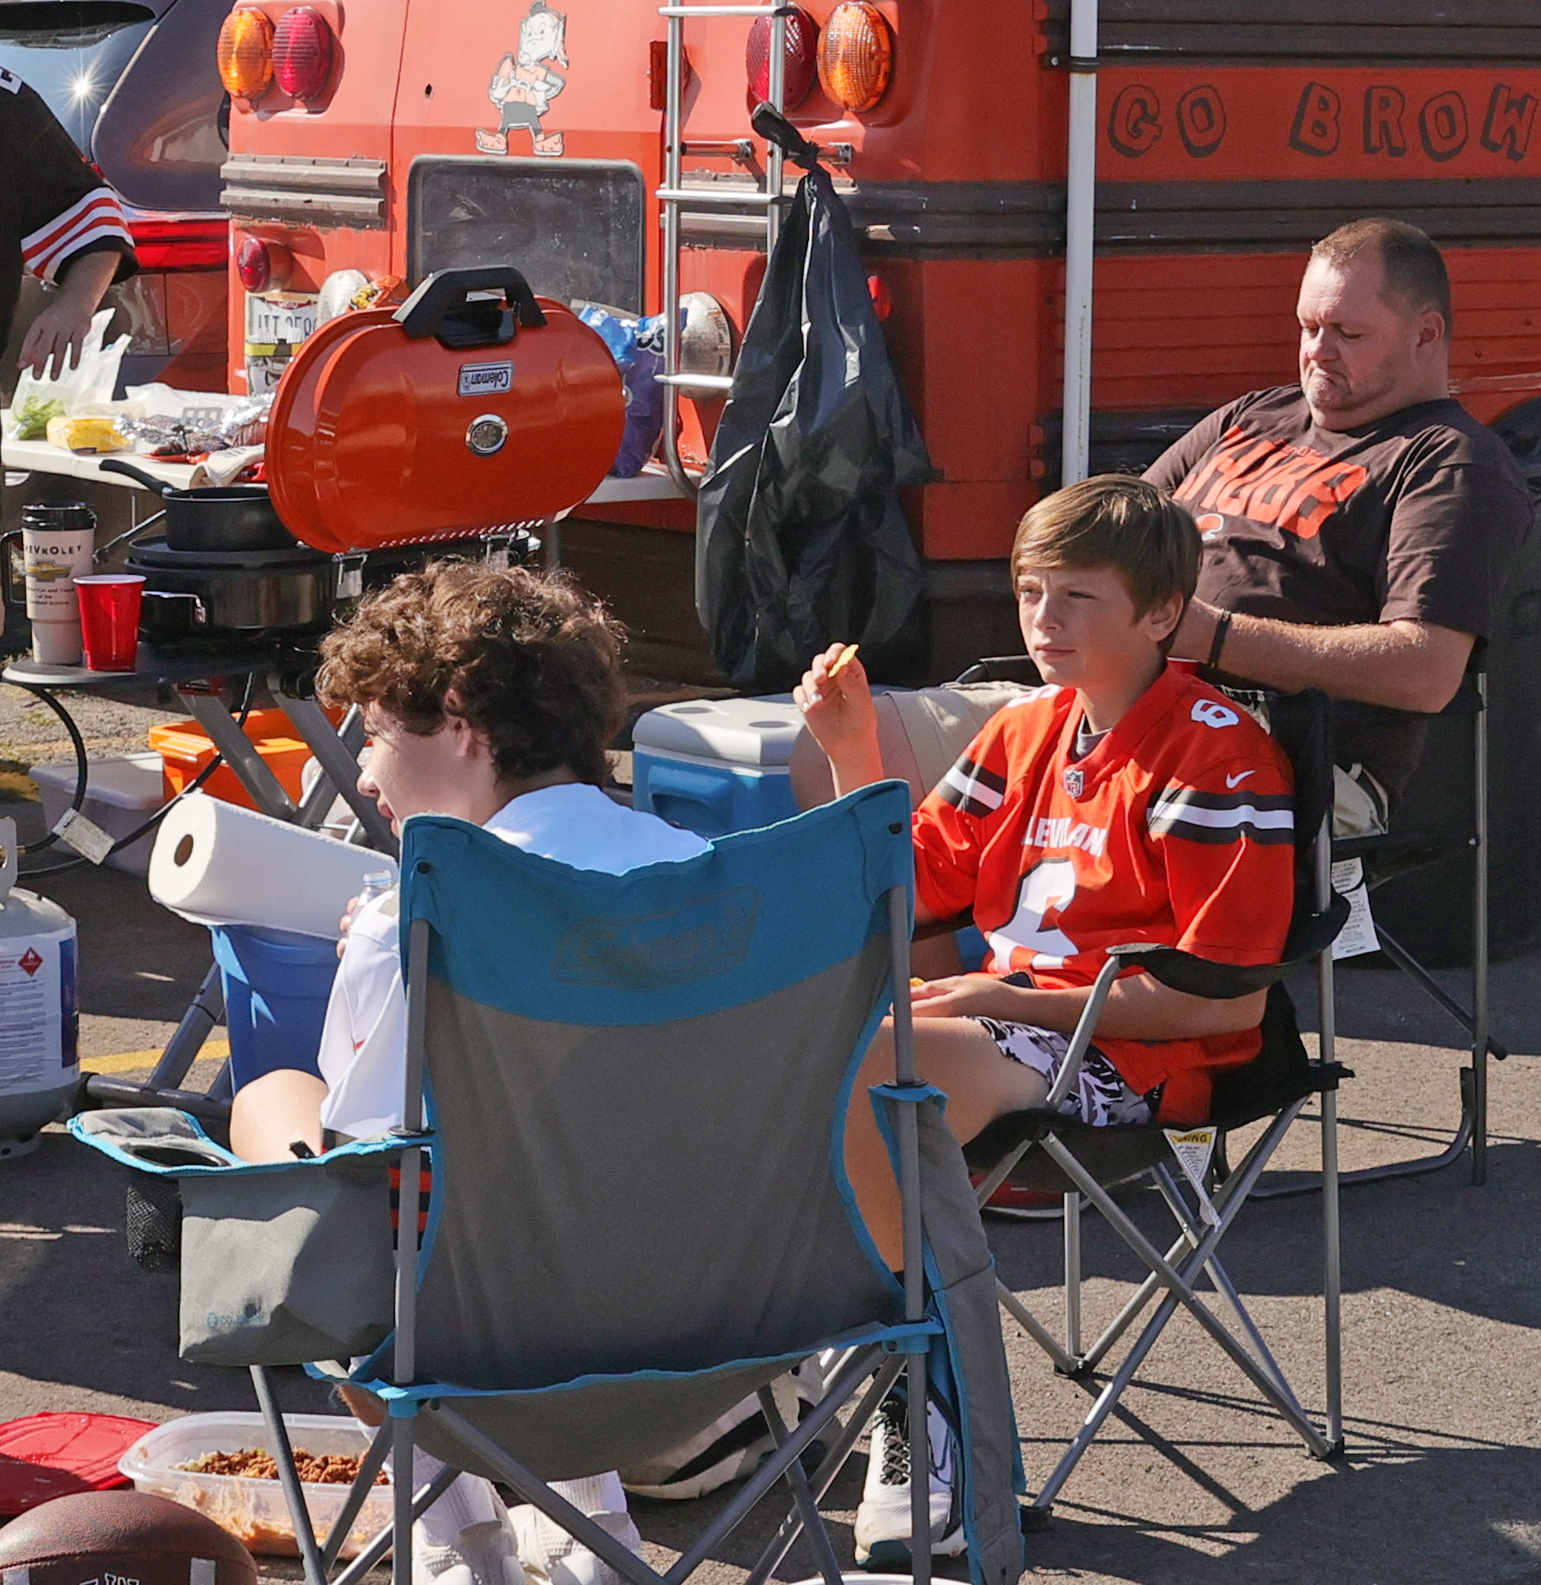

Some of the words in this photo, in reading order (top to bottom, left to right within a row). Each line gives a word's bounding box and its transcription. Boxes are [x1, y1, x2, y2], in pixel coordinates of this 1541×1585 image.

[1107, 84, 1227, 158] GO
[471, 369, 509, 388] Coleman
[1191, 699, 1240, 729] 6
